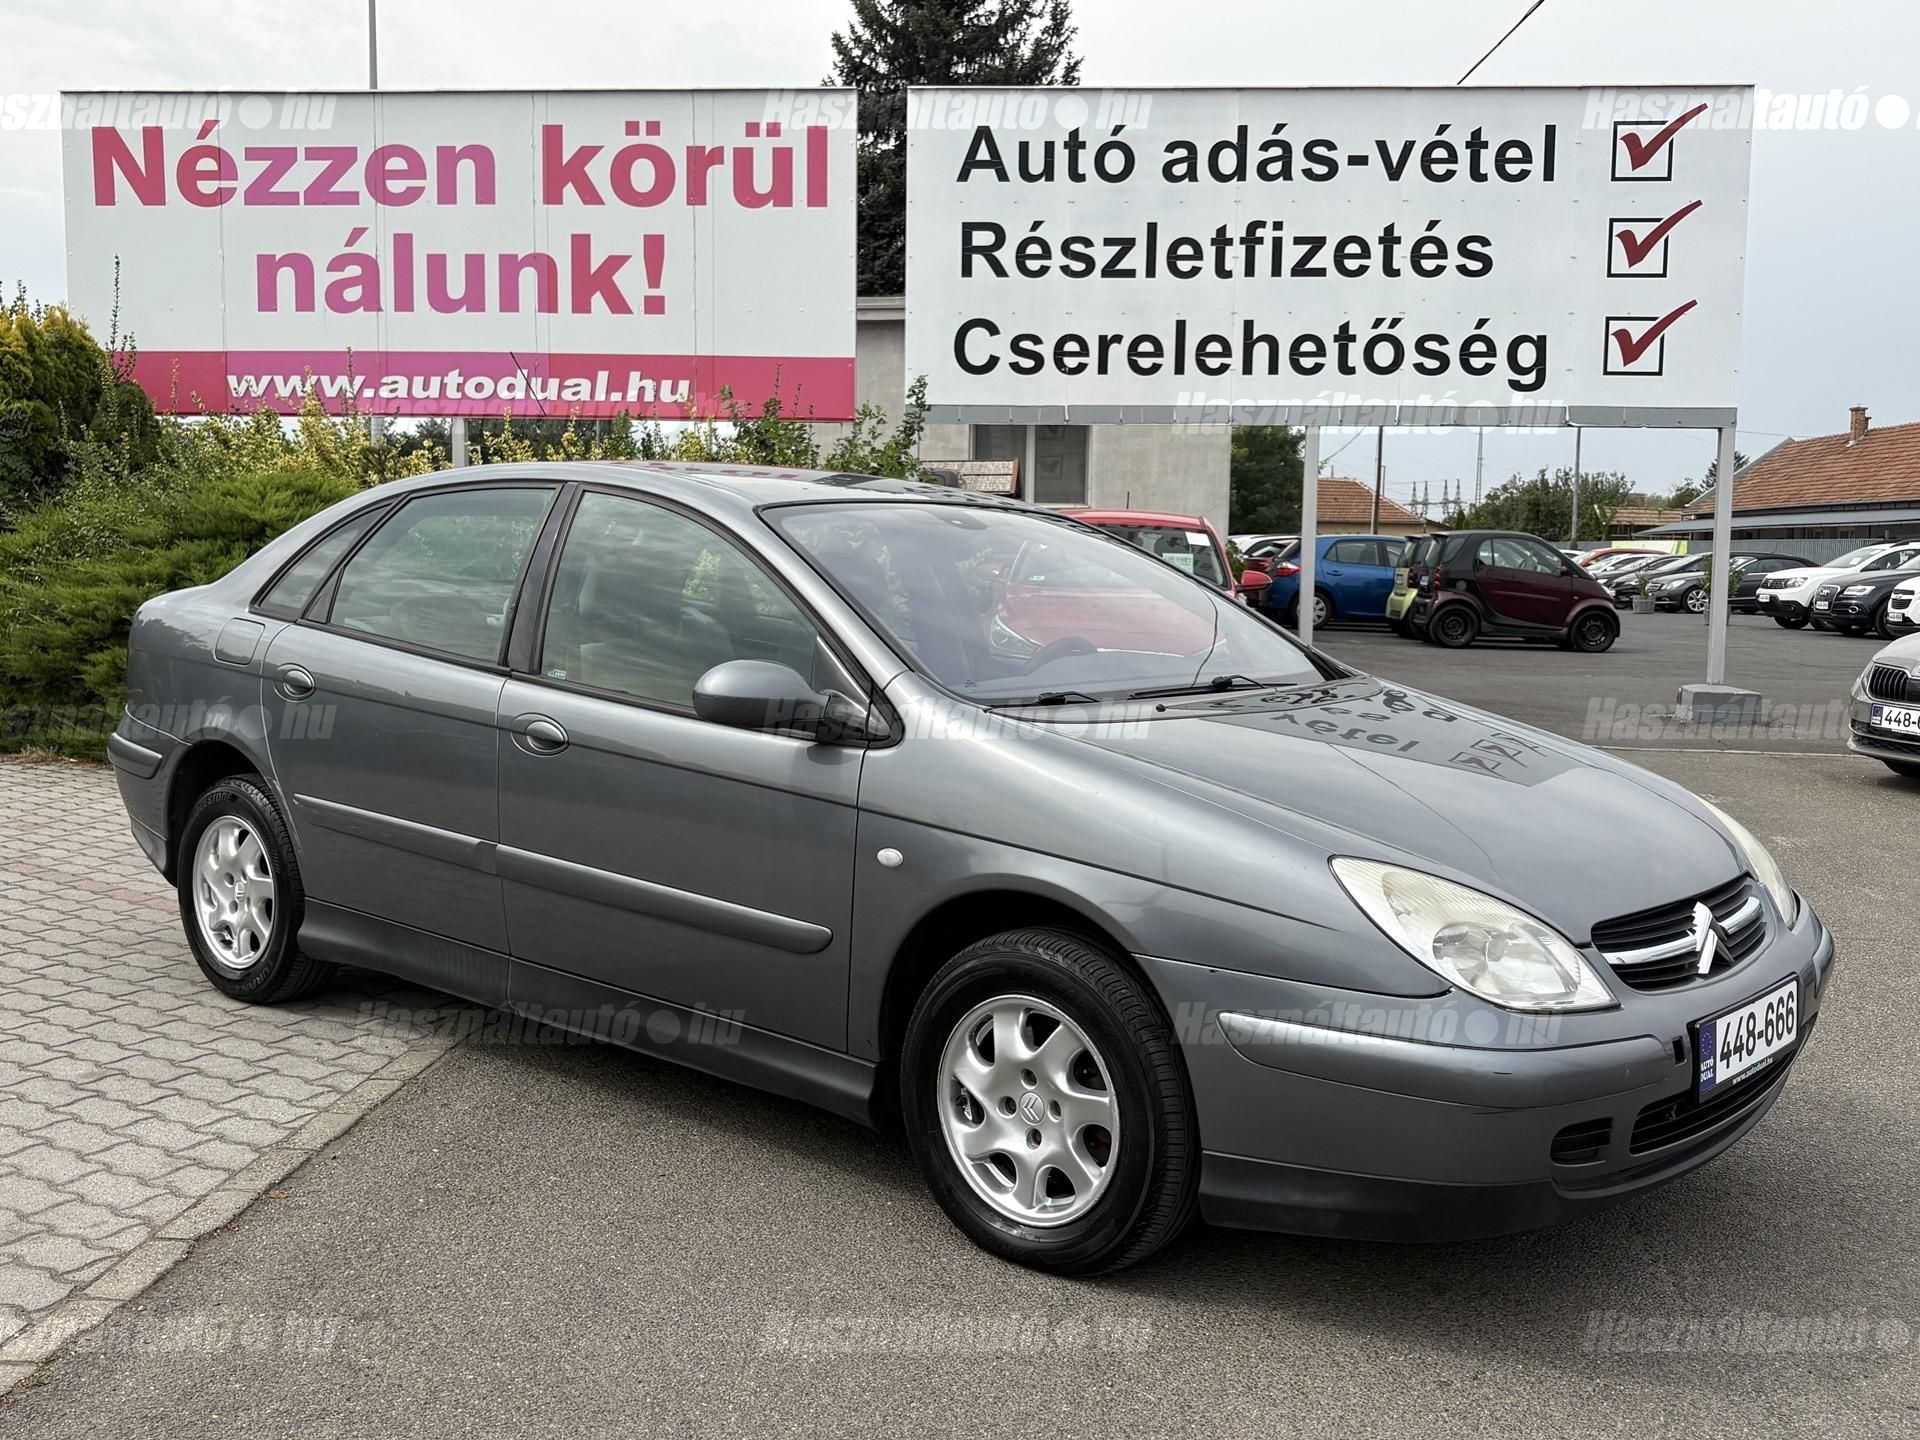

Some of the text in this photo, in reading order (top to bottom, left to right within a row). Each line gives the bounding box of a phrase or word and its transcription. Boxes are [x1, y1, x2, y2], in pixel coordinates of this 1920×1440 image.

[92, 120, 829, 208] Nézzen körül
[957, 123, 1557, 185] Autó adás-vétel
[257, 227, 666, 315] nálunk!
[961, 219, 1494, 280] Részletfizetés
[226, 367, 691, 404] www.autodual.hu
[954, 317, 1548, 393] Cserelehetőség
[1719, 990, 1795, 1070] 448-666
